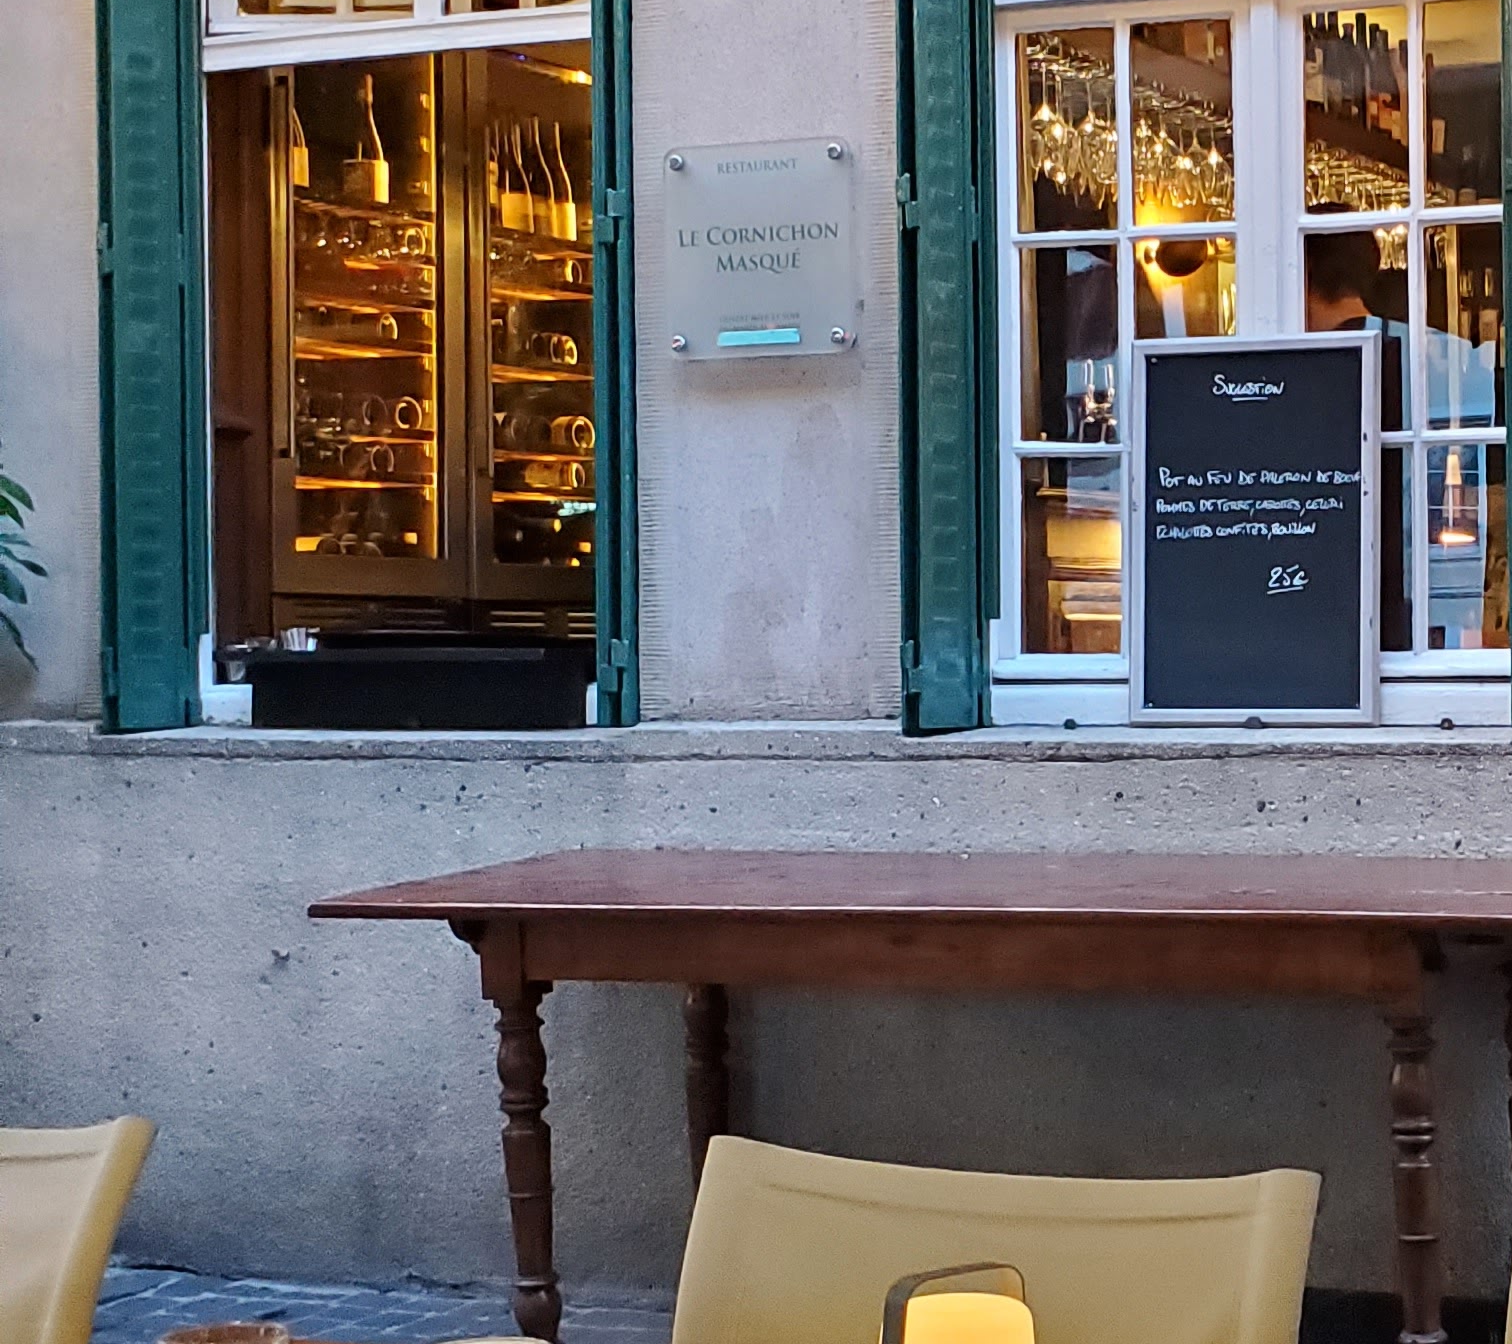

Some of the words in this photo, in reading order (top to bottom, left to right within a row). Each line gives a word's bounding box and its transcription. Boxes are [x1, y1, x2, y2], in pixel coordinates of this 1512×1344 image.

[716, 158, 798, 175] RESTAURANT
[678, 229, 700, 248] LE
[706, 222, 839, 246] CORNICHON
[1187, 475, 1203, 487] AU
[1206, 471, 1232, 485] FEU
[1238, 470, 1258, 485] DE
[1316, 470, 1333, 484] DE
